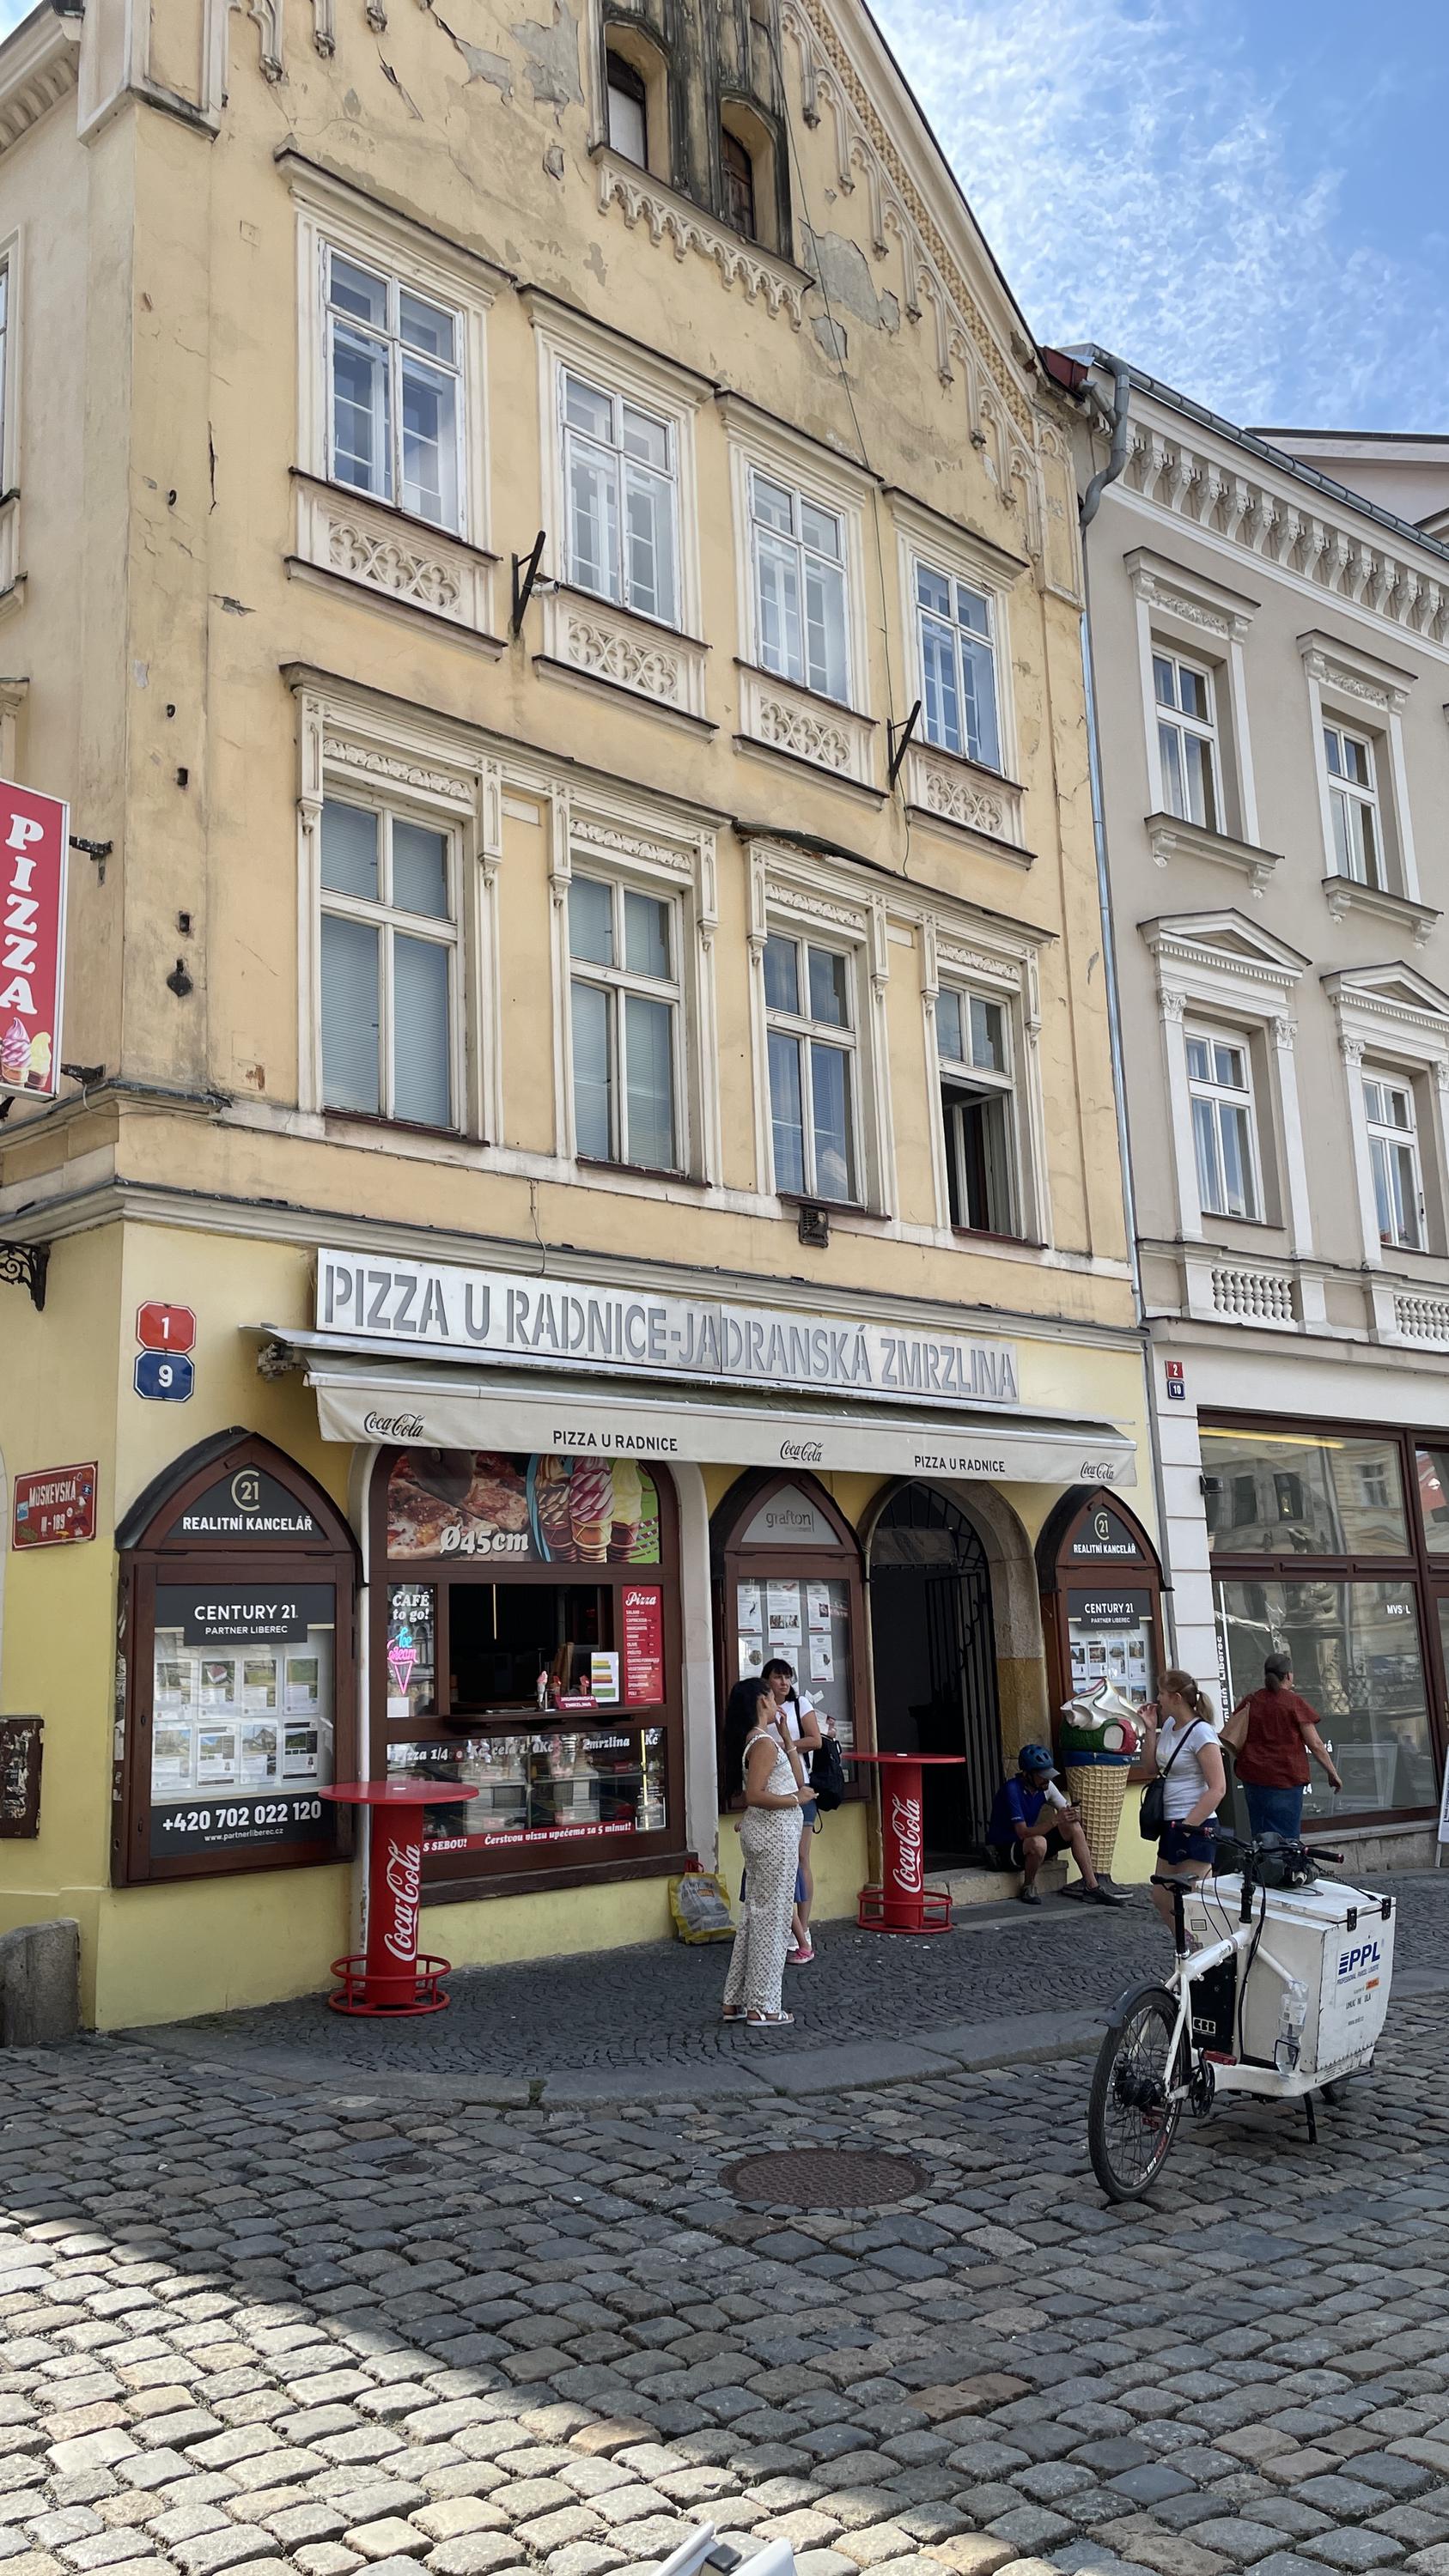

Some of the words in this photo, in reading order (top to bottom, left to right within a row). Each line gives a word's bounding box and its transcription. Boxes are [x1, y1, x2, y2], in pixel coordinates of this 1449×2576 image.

[0, 813, 44, 1015] PIZZA
[161, 1316, 170, 1340] 1
[325, 1265, 449, 1337] PIZZA
[465, 1283, 490, 1341] U
[507, 1288, 872, 1382] RADNICE-JADRANSKÁ
[880, 1338, 1017, 1398] ZMRZLINA
[158, 1364, 174, 1388] 9
[1172, 1364, 1178, 1376] 2
[1172, 1385, 1182, 1395] 10
[364, 1410, 425, 1438] Coca-Cola
[552, 1430, 598, 1448] PIZZA
[600, 1433, 612, 1449] U
[615, 1435, 679, 1453] RADNICE
[780, 1439, 824, 1462] Coca-Cola
[914, 1455, 947, 1470] PIZZA
[949, 1456, 958, 1472] U
[959, 1458, 1006, 1473] RADNICE
[1080, 1460, 1115, 1480] Coca-Cola
[28, 1476, 76, 1508] MOSKEVSKÁ
[182, 1515, 243, 1531] REALITNÍ
[246, 1515, 313, 1531] KANCELÁŘ
[766, 1510, 812, 1528] grafton
[440, 1522, 529, 1556] Ø45cm
[1073, 1541, 1103, 1554] REALITNÍ
[1103, 1542, 1137, 1555] KANCELÁŘ
[392, 1592, 429, 1607] CAFÉ
[625, 1591, 657, 1607] Pizza
[1084, 1602, 1124, 1614] CENTURY
[1125, 1601, 1134, 1613] 21
[193, 1606, 277, 1621] CENTURY
[280, 1604, 296, 1619] 21
[393, 1608, 406, 1620] to
[409, 1608, 429, 1623] go!
[205, 1626, 248, 1635] PARTNER
[250, 1625, 288, 1634] LIBEREC
[429, 1746, 449, 1761] 1/4
[162, 1810, 210, 1832] +420
[215, 1807, 250, 1829] 702
[254, 1804, 289, 1825] 022
[292, 1801, 322, 1821] 120
[204, 1828, 283, 1842] www.partnerliberec.cz
[423, 1843, 430, 1852] S
[431, 1838, 468, 1851] SEBOU!
[484, 1831, 523, 1846] Čerstvou
[549, 1826, 585, 1841] upečeme
[587, 1826, 596, 1835] za
[598, 1825, 604, 1835] 5
[605, 1821, 632, 1833] minut!
[892, 1793, 921, 1893] Coca-Cola
[384, 1838, 421, 1962] Coca-Cola
[1349, 1941, 1381, 1972] PPL
